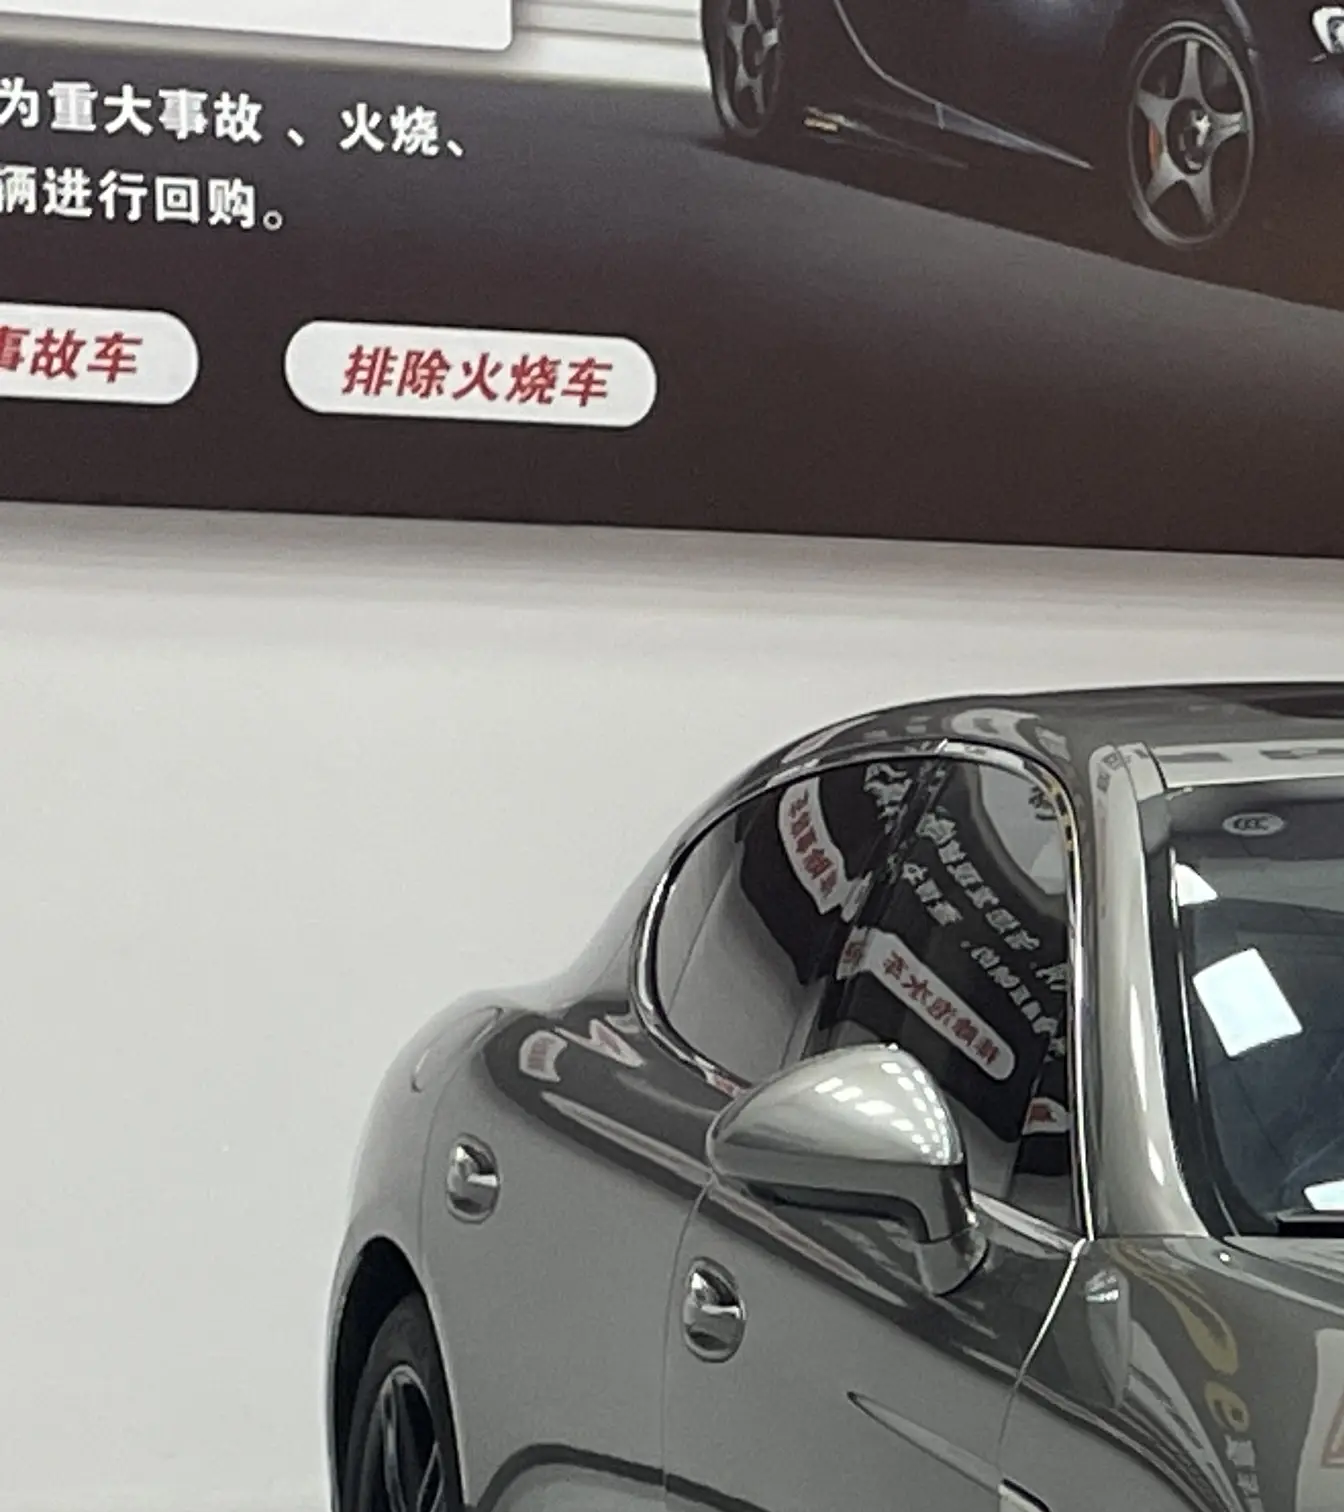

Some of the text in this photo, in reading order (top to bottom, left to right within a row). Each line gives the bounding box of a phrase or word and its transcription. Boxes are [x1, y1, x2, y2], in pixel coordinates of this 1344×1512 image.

[341, 345, 613, 407] 排除火烧车
